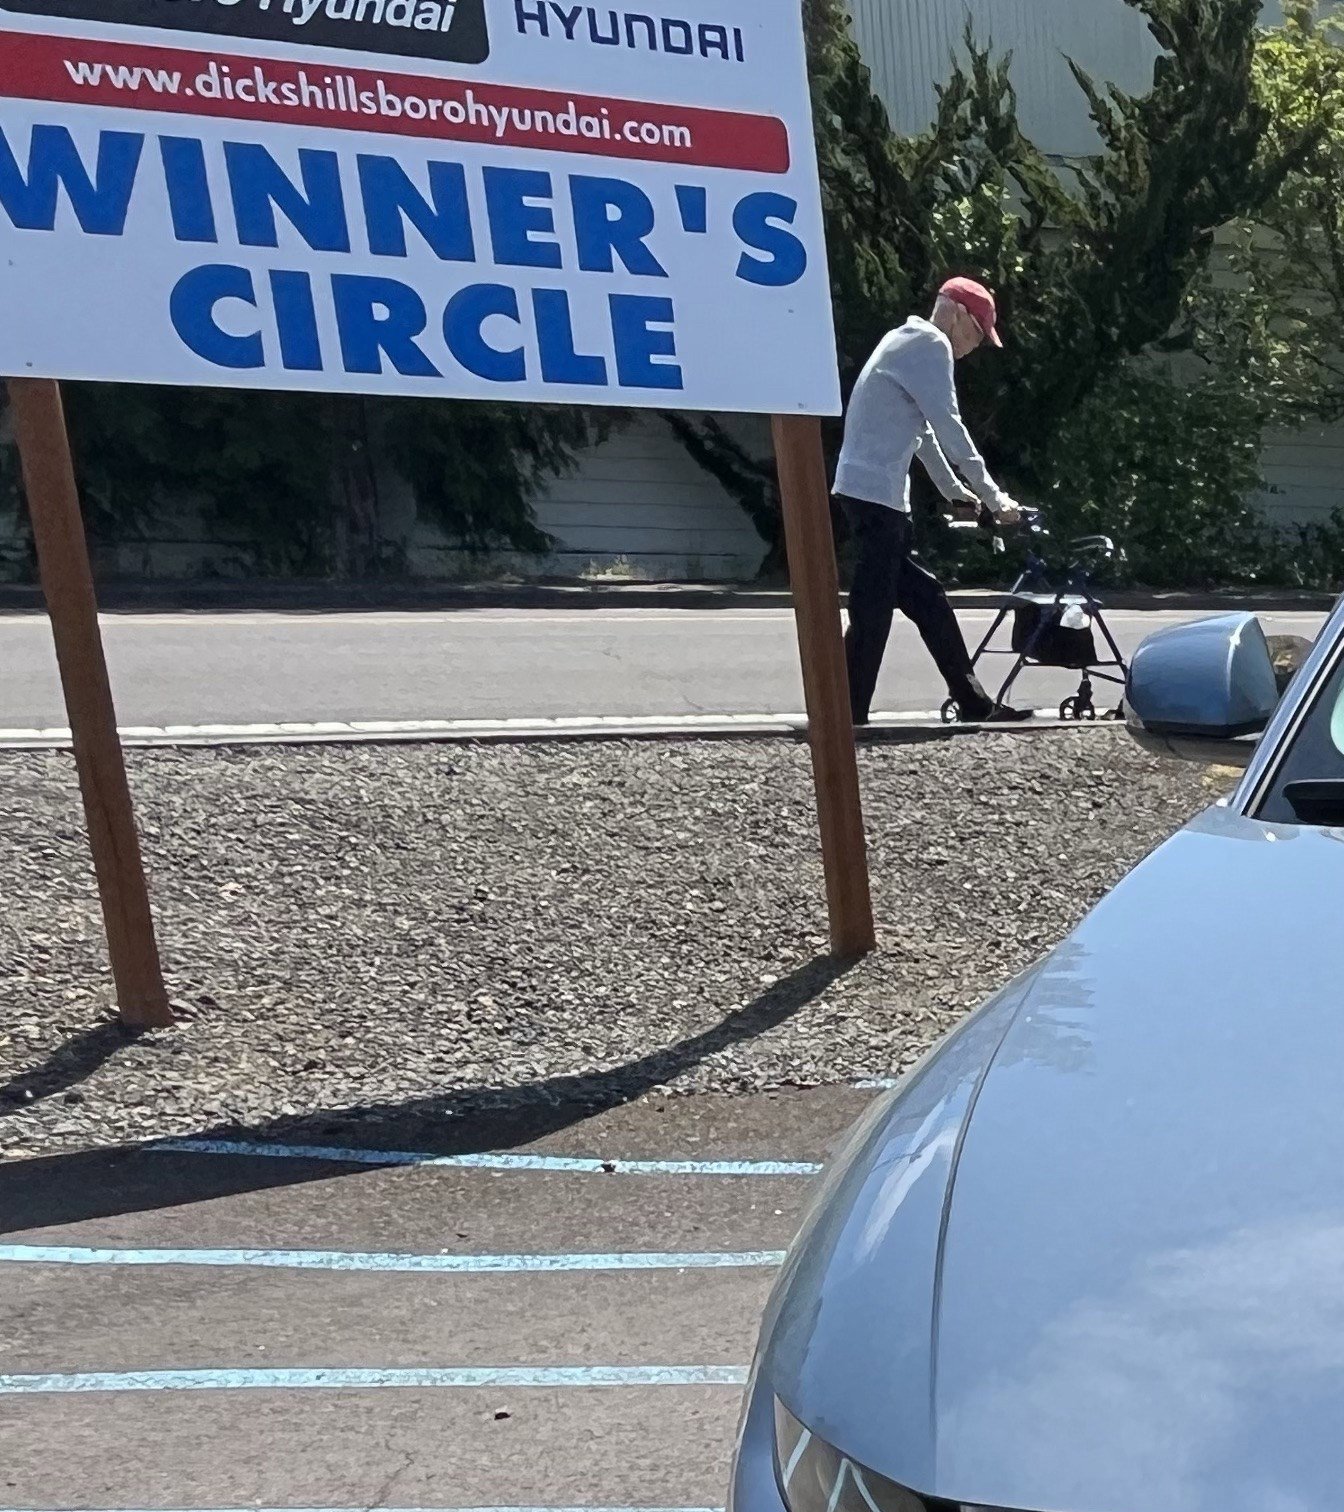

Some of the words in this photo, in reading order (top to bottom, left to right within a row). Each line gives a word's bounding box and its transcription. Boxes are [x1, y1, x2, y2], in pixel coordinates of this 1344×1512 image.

[514, 0, 745, 62] HYUNDAI
[63, 58, 692, 147] www.dickshillsborohyundai.com
[0, 124, 807, 287] WINNER'S
[169, 263, 684, 390] CIRCLE
